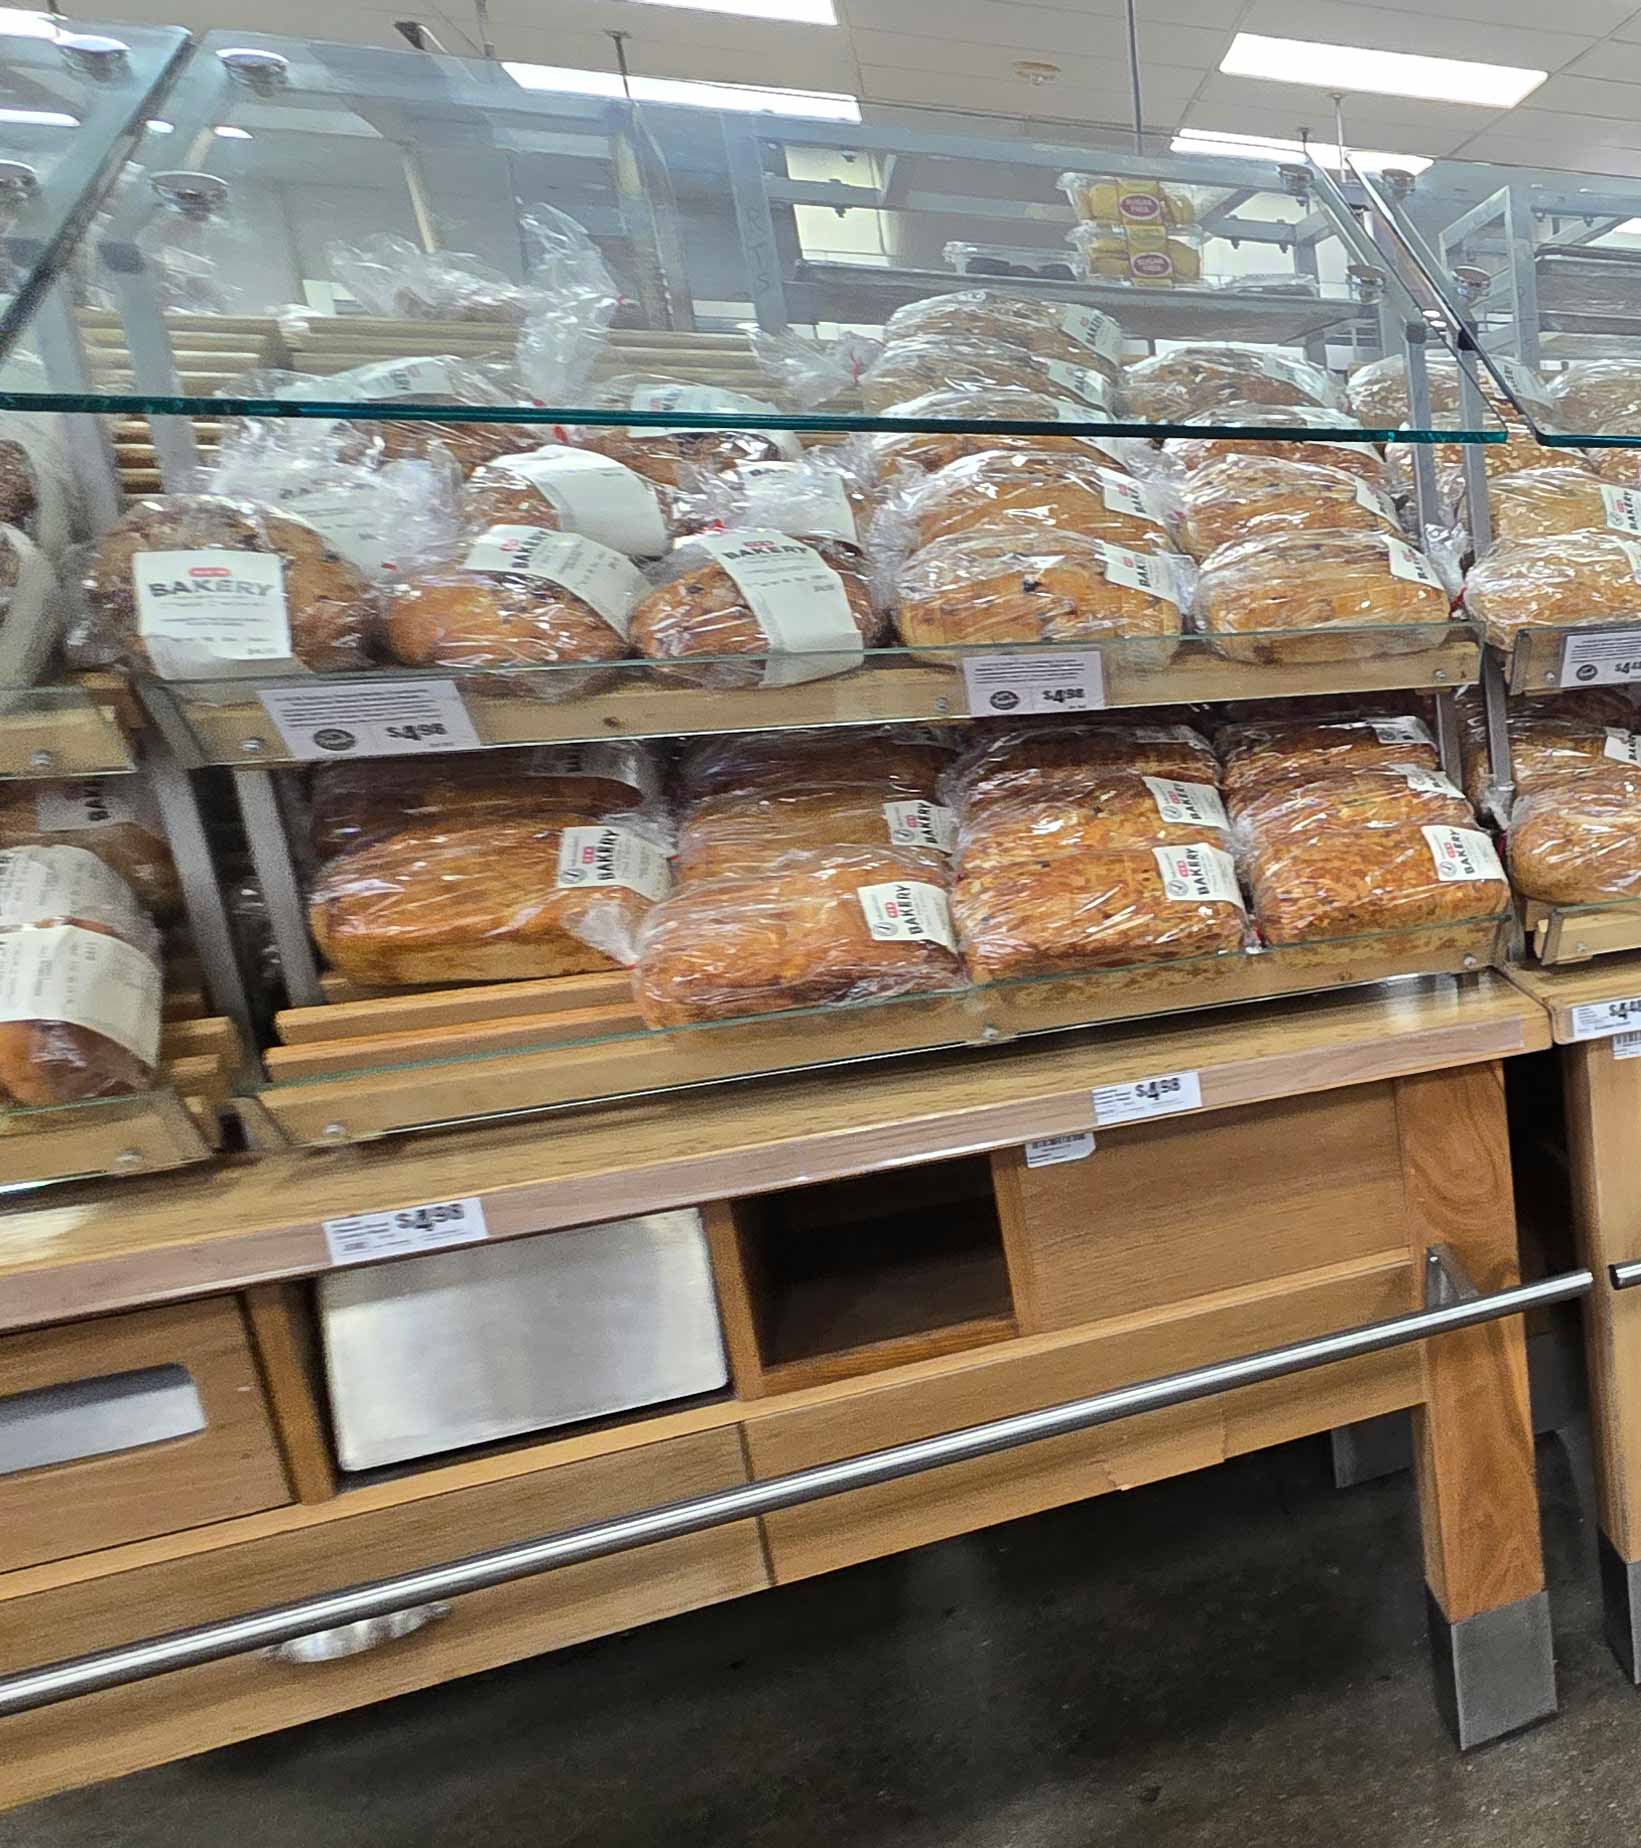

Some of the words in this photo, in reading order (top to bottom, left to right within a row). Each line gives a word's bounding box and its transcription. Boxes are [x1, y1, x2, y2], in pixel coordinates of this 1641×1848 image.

[721, 545, 807, 560] BAKERY
[149, 579, 275, 598] BAKERY
[918, 802, 938, 844] BAKERY
[597, 829, 620, 880] BAKERY
[1186, 848, 1210, 896] BAKERY
[1450, 829, 1475, 874] BAKERY
[896, 885, 924, 935] BAKERY
